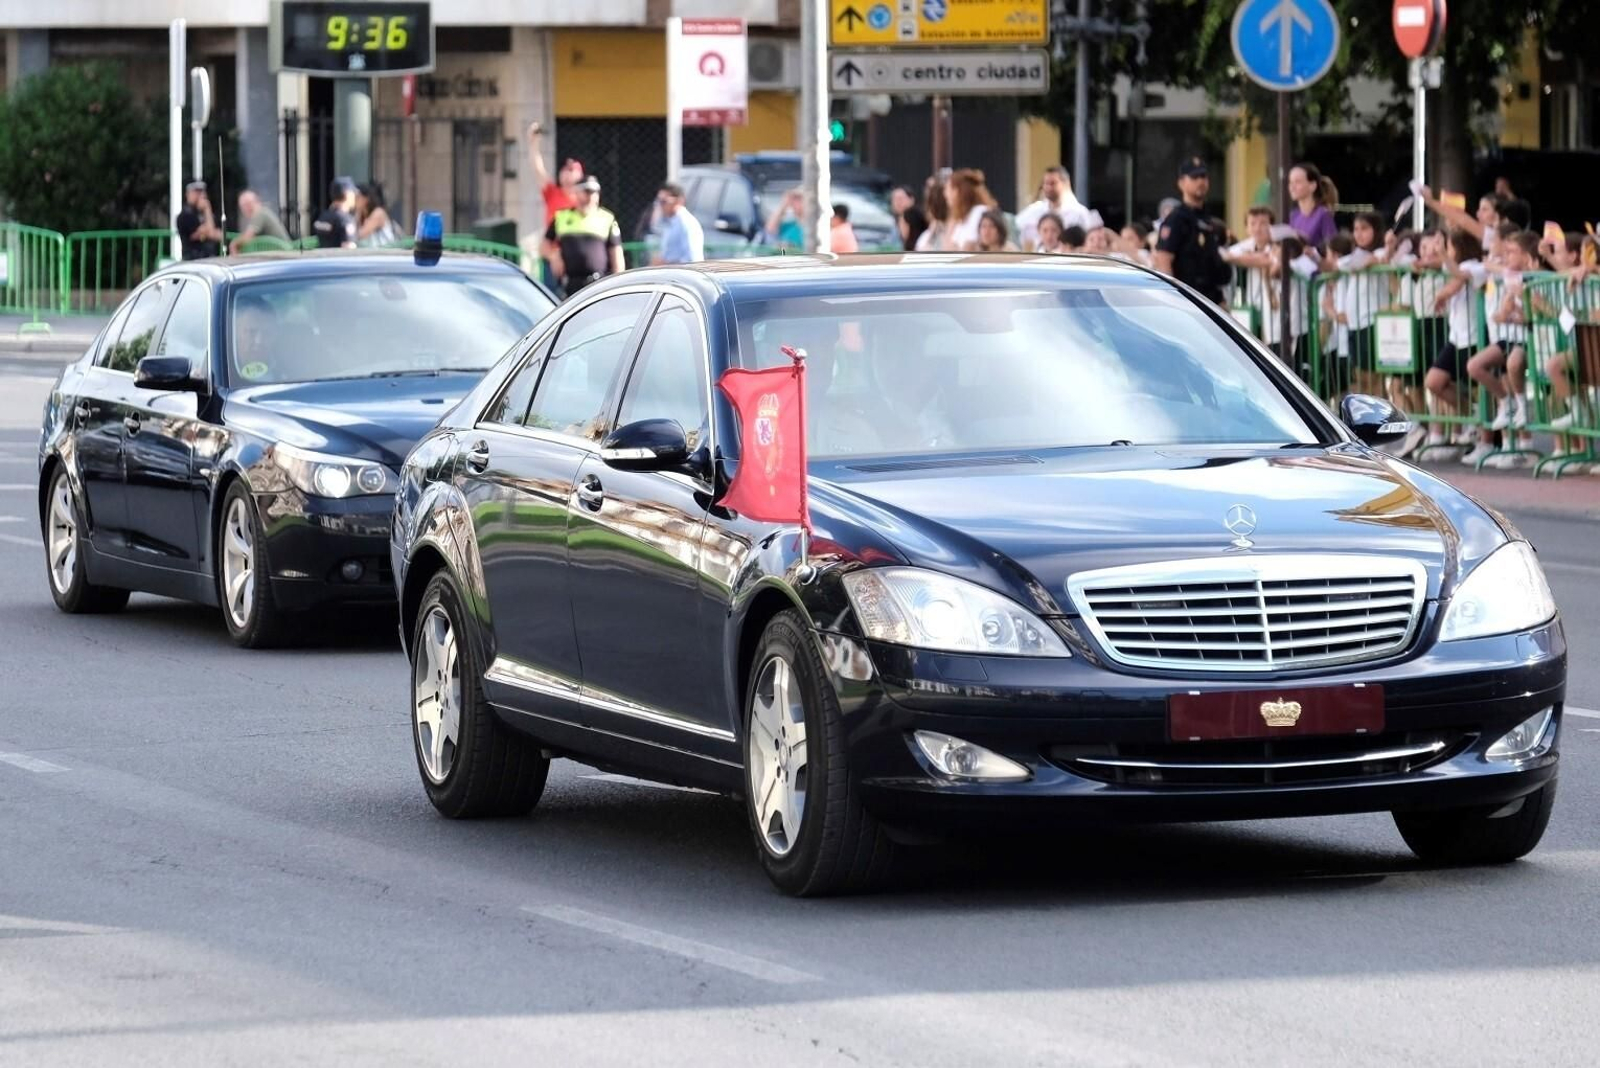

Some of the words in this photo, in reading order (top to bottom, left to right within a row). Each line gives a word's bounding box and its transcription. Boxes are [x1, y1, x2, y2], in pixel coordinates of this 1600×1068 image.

[326, 15, 408, 50] 9:36
[902, 64, 966, 81] centro
[976, 62, 1041, 80] ciudad
